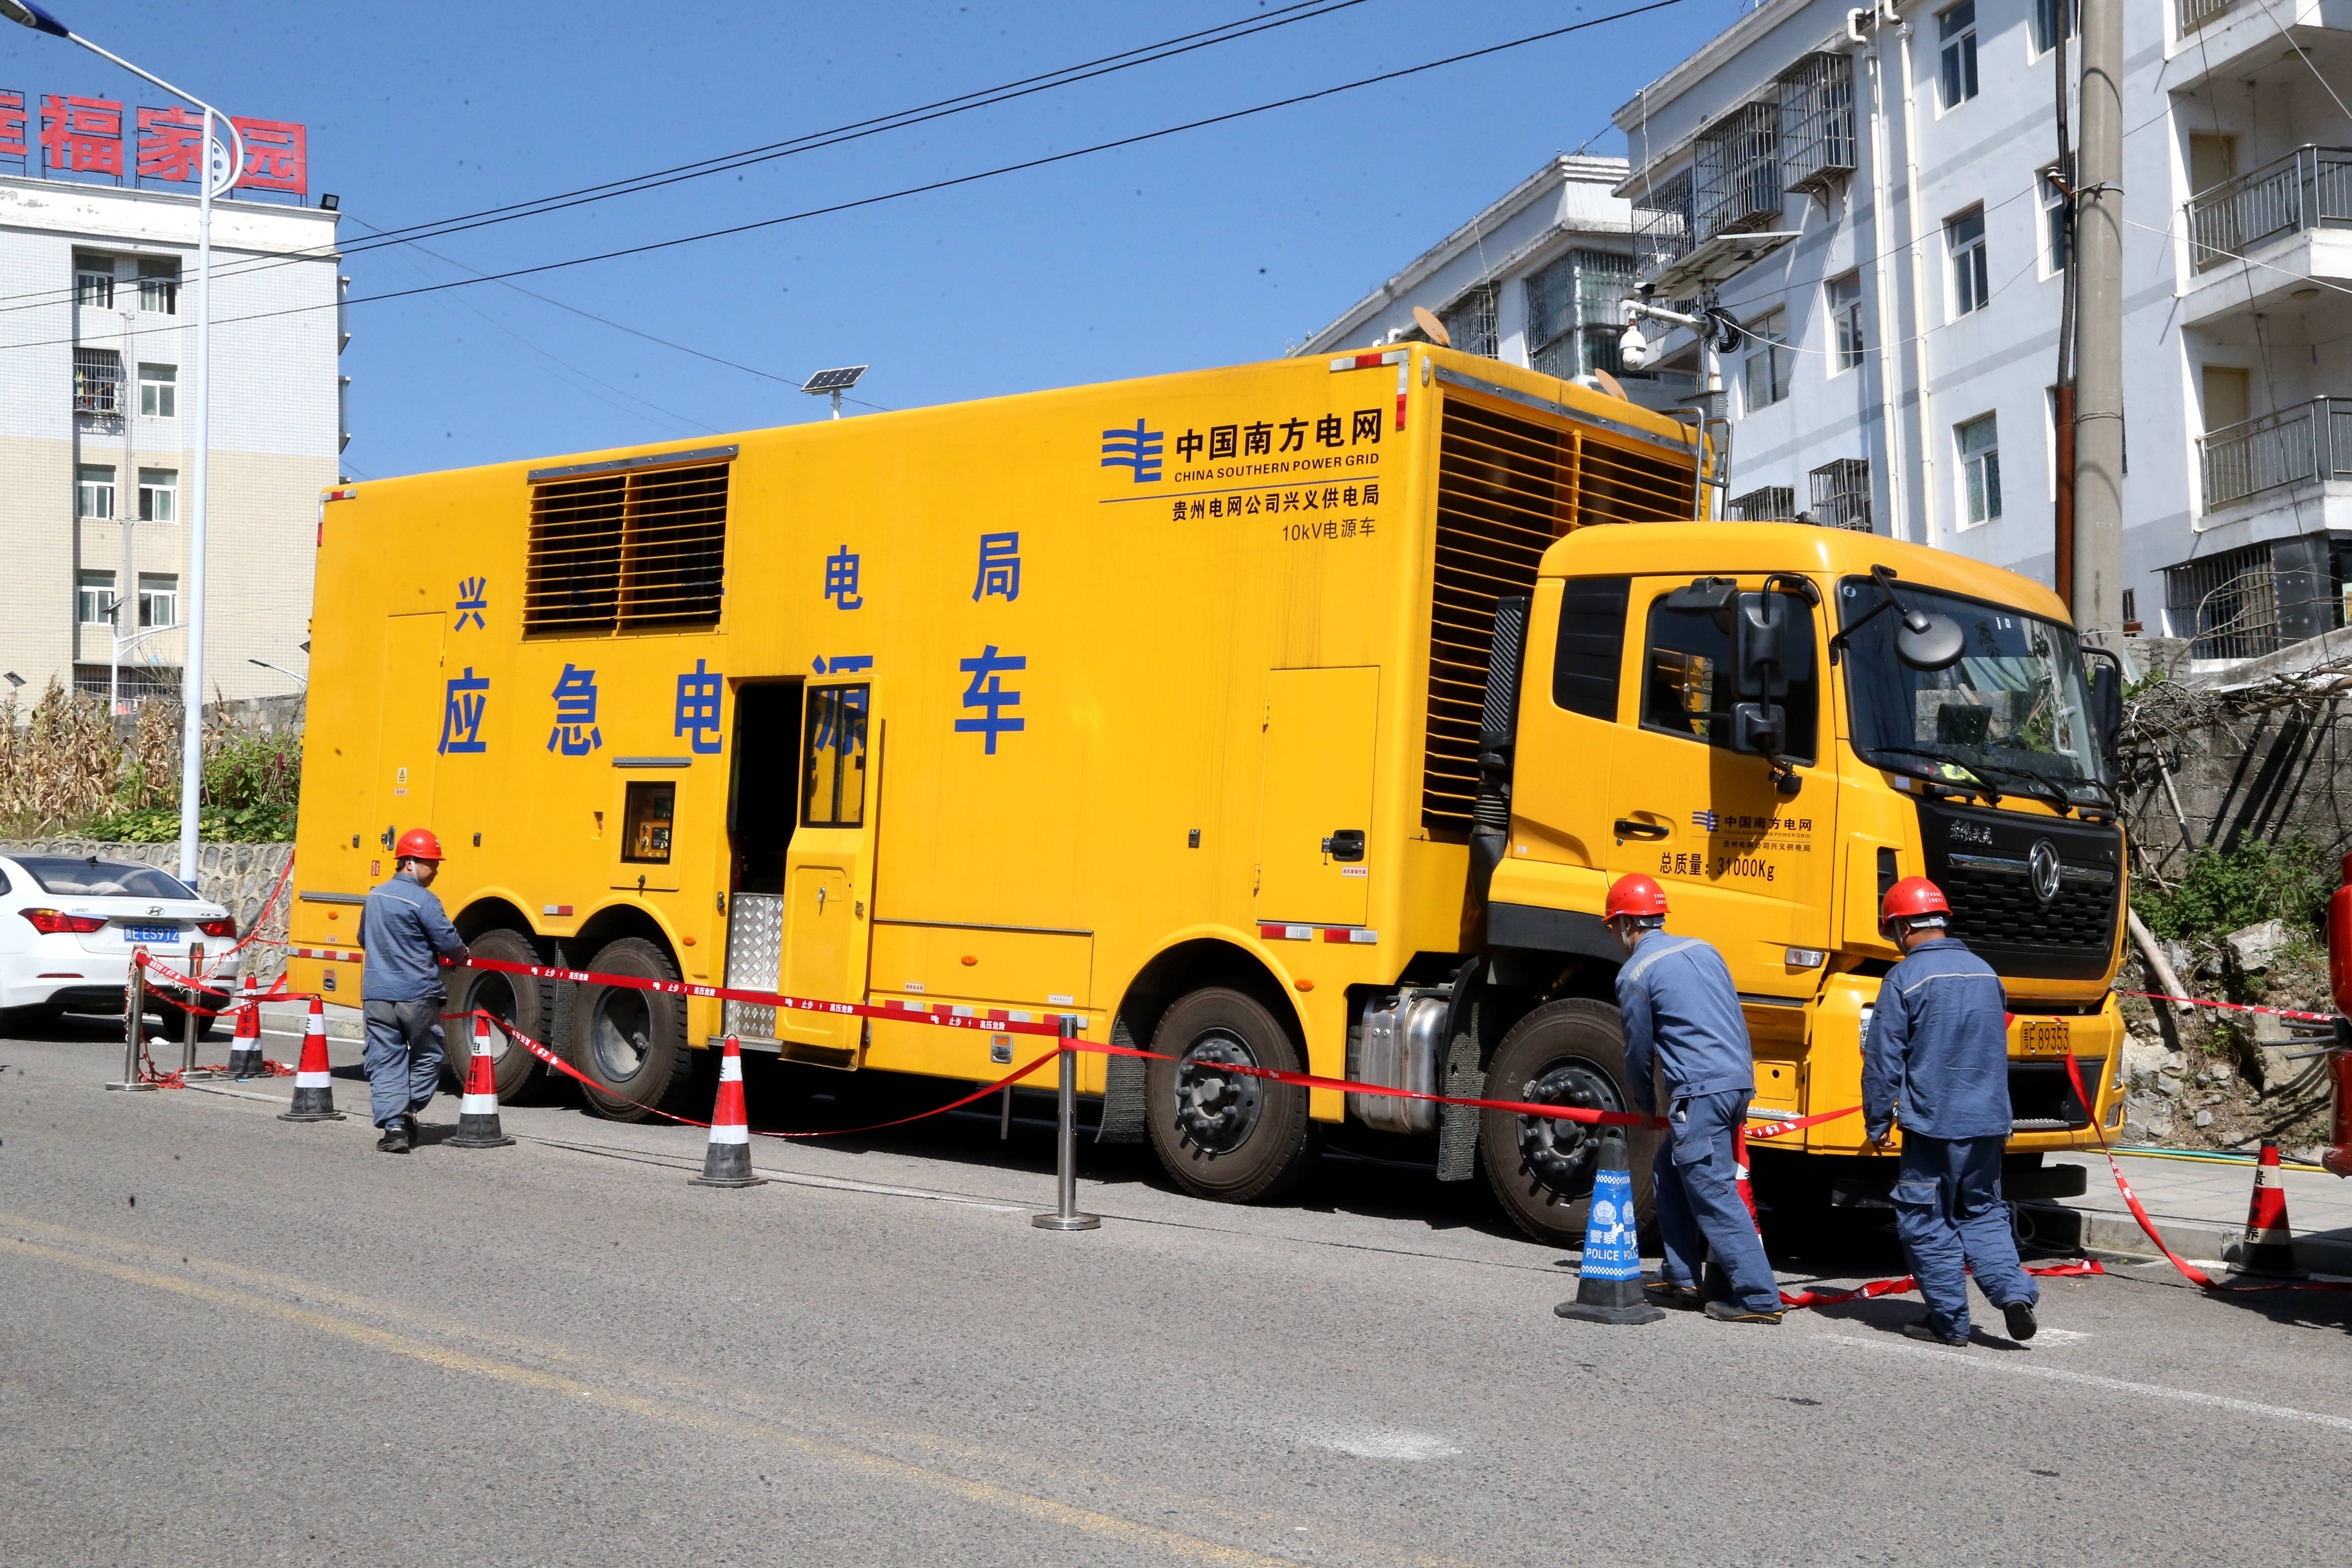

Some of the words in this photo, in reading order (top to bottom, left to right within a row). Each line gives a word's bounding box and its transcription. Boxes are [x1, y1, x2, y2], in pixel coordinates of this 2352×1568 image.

[1176, 408, 1382, 463] 中国南方电网
[1174, 469, 1214, 483] CHINA
[1217, 461, 1289, 479] SOUTHERN
[1293, 456, 1342, 471] POWER
[1345, 453, 1379, 466] GRID
[1172, 484, 1379, 522] 贵州电网公司兴义供电局
[1282, 516, 1376, 541] 10kV电源车
[1725, 815, 1812, 831] 中国南方电网
[1723, 840, 1811, 852] 贵州电网公司兴义供电局
[544, 969, 555, 977] 止步
[667, 983, 679, 992] 止步
[694, 986, 715, 996] 高压危险
[801, 1000, 813, 1009] 止步
[830, 1003, 853, 1014] 高压危险
[948, 1017, 961, 1026] 止步
[980, 1020, 1005, 1030] 高压危险
[1586, 1248, 1619, 1261] POLICE
[1624, 1249, 1638, 1261] POLIC
